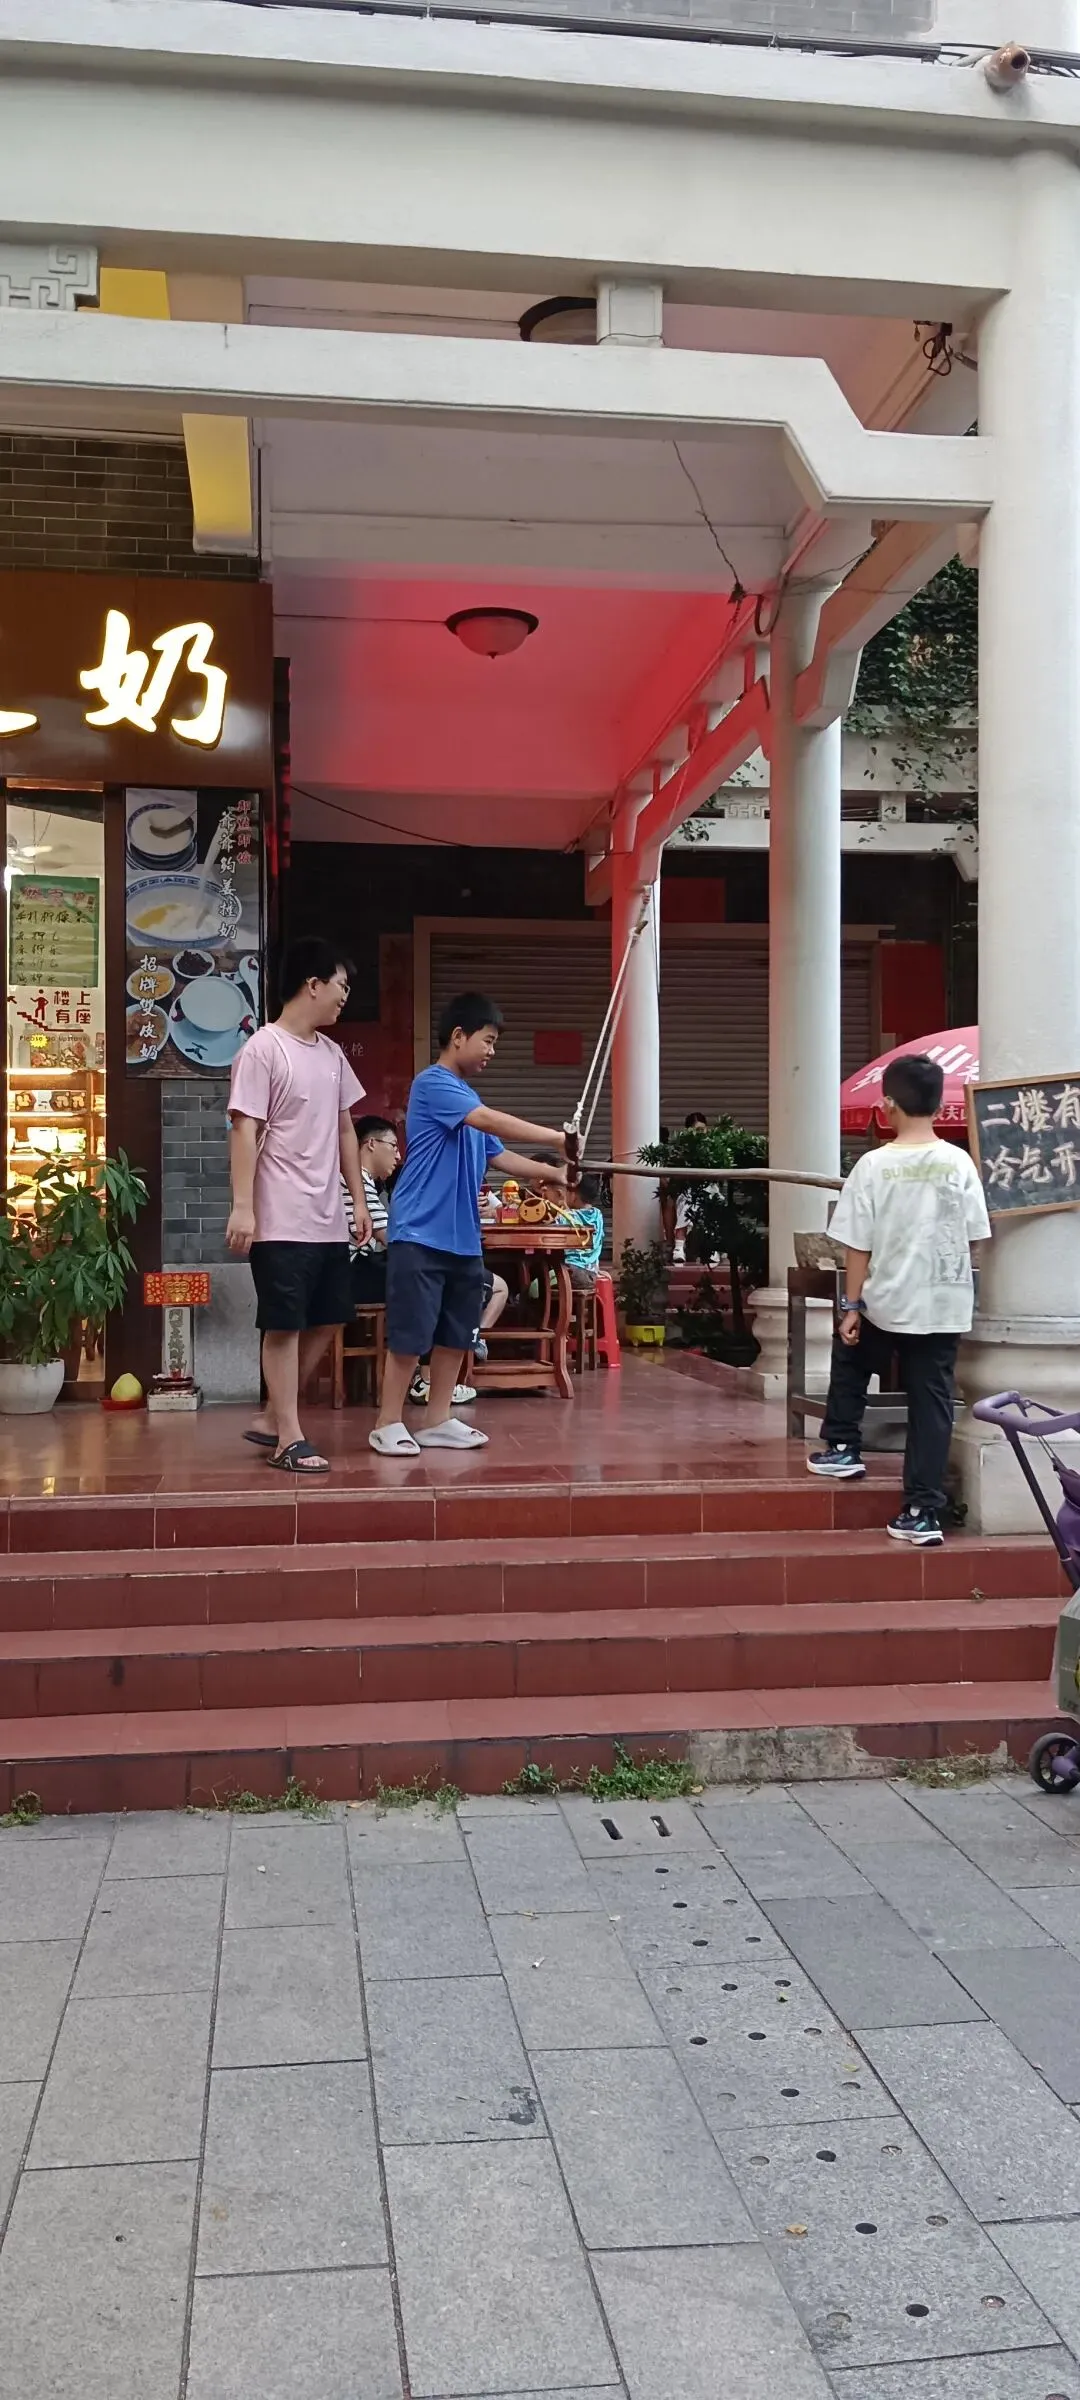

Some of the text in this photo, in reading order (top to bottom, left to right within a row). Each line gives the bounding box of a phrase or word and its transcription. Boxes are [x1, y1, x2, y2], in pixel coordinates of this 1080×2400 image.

[0, 609, 228, 746] 奶
[54, 990, 91, 1006] 楼上
[55, 1008, 91, 1025] 有座
[984, 1141, 1080, 1191] 冷气开
